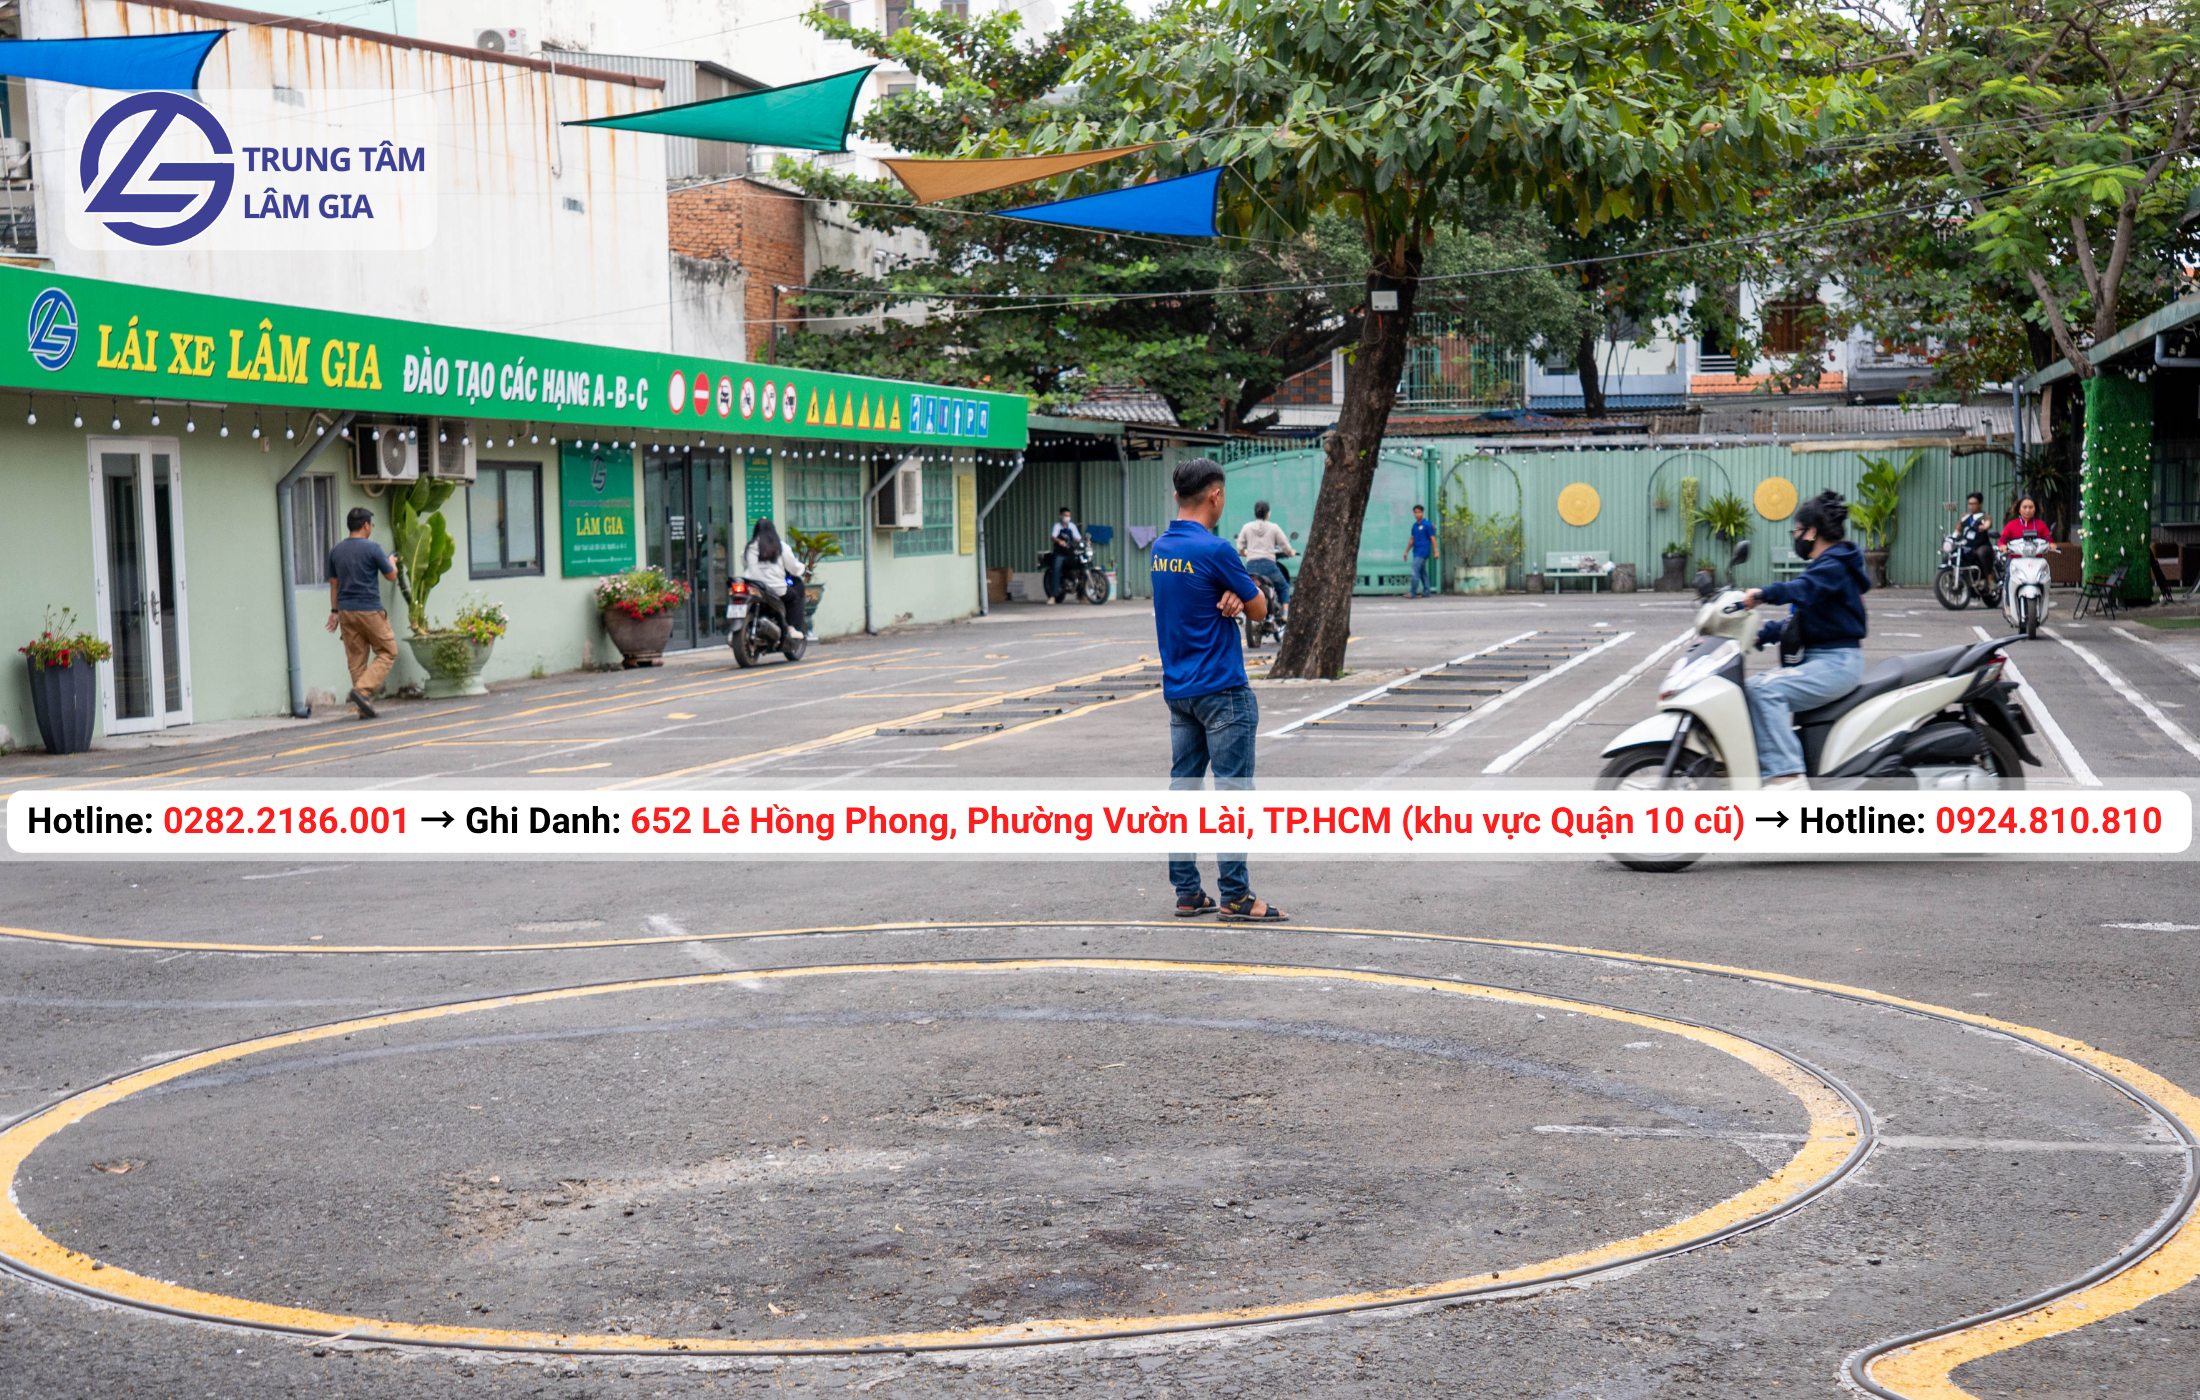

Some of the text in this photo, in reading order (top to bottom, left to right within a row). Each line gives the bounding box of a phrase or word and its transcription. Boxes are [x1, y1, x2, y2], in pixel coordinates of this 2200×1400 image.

[97, 315, 382, 390] LÁI XE LÂM GIA
[403, 346, 449, 396] ĐÀO
[455, 360, 495, 405] TẠO
[500, 357, 538, 402] CÁC
[542, 368, 590, 411] HẠNG
[576, 512, 624, 536] LÂM GIA
[1150, 554, 1194, 574] ÂM GIA
